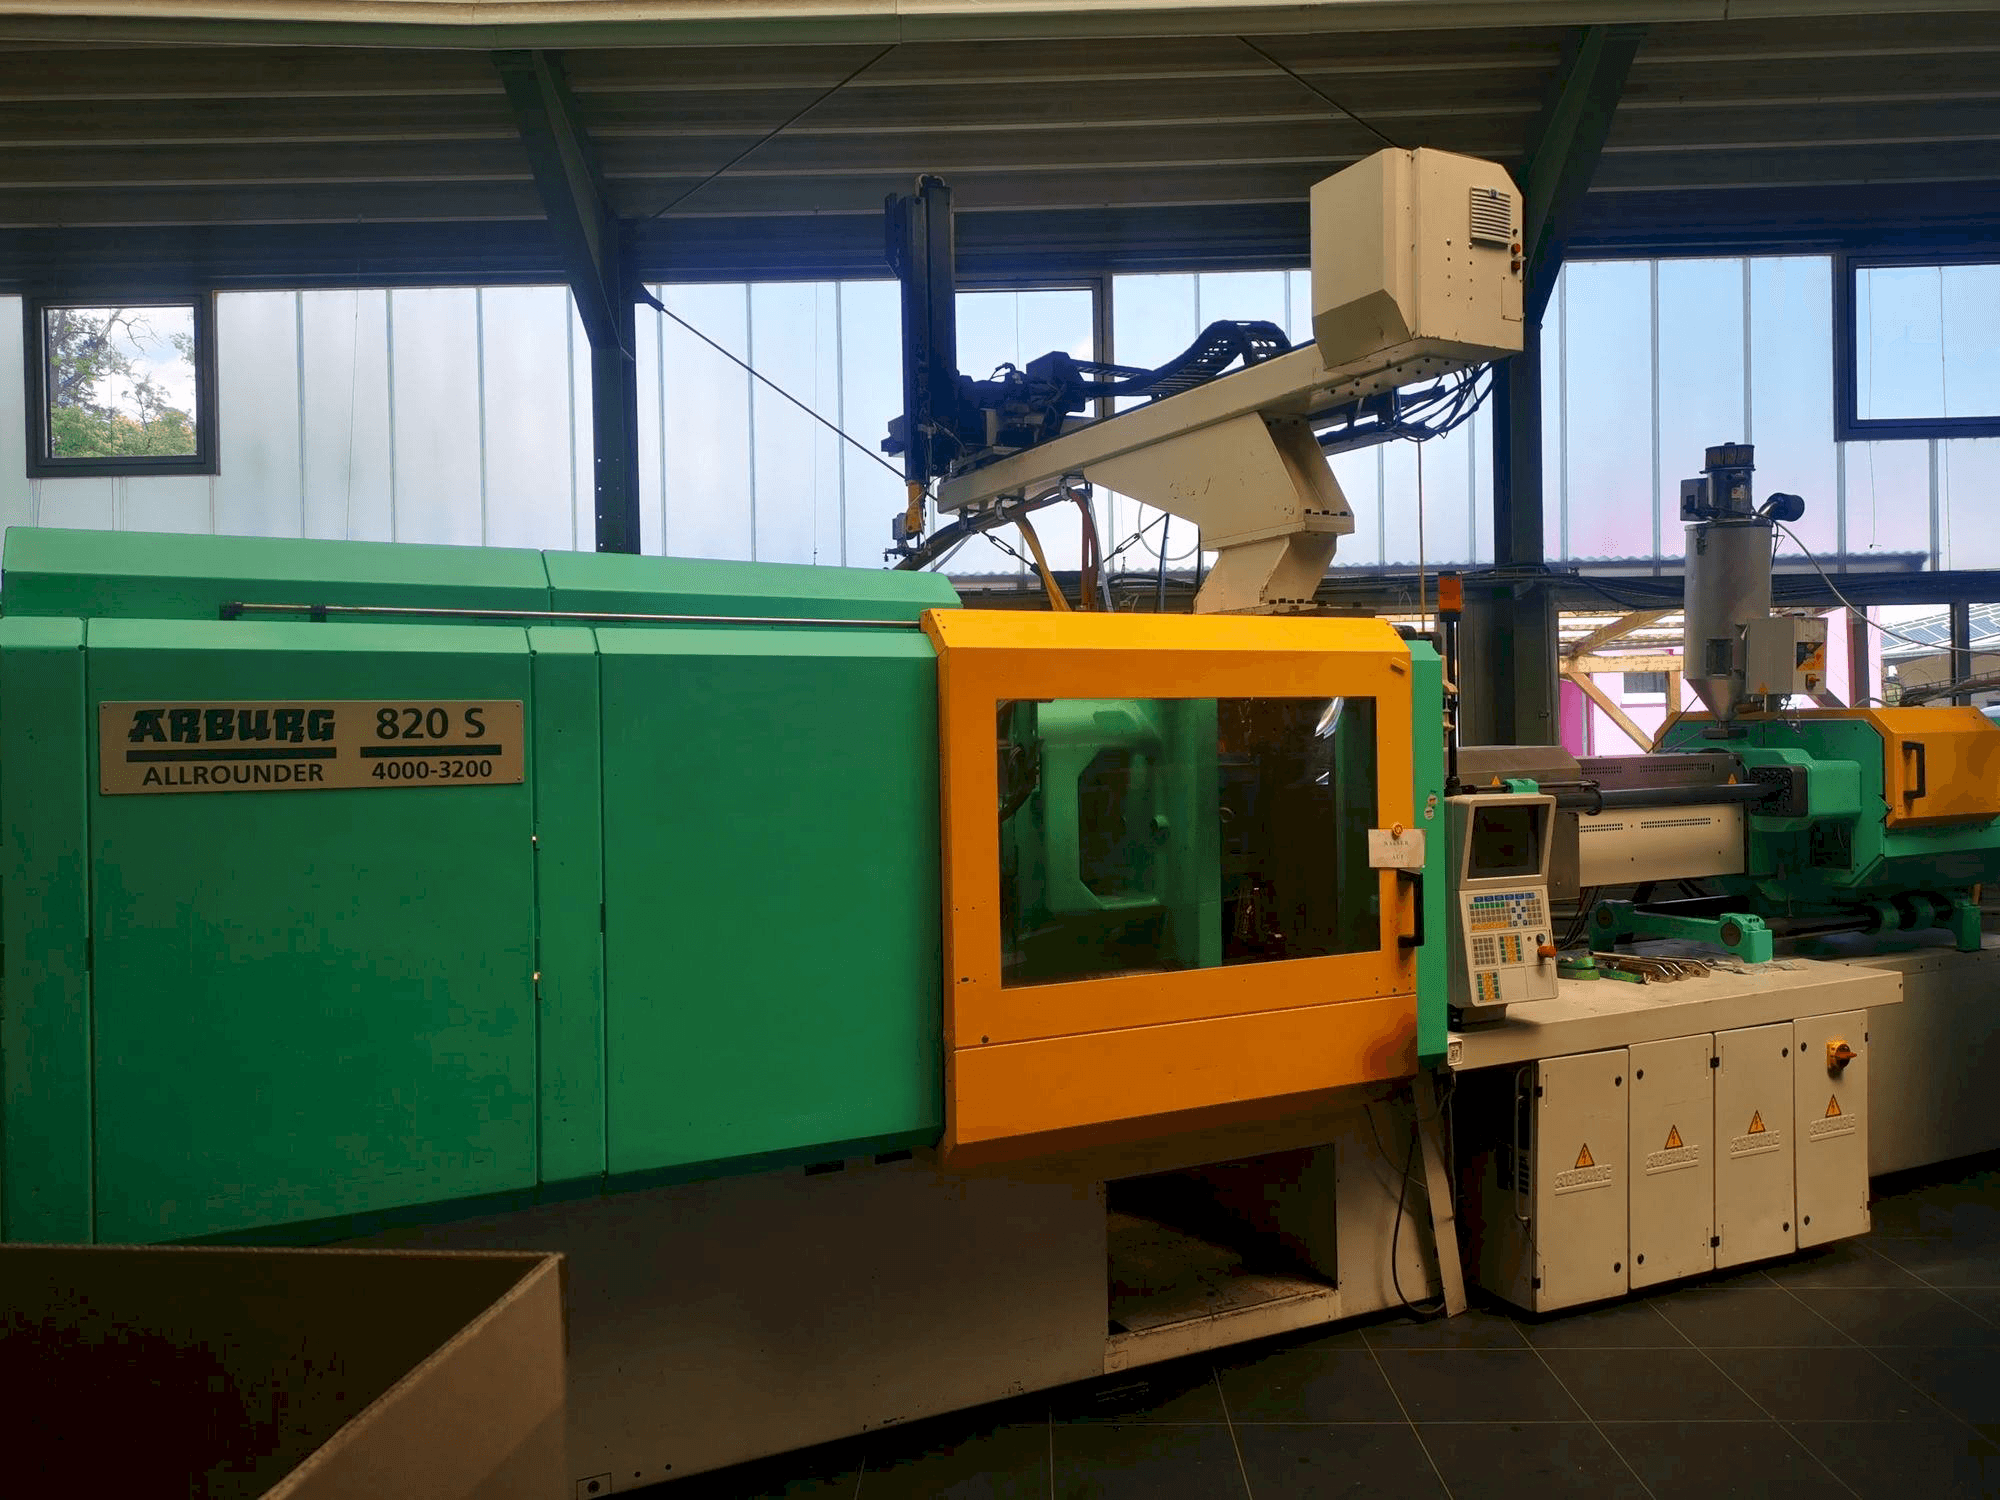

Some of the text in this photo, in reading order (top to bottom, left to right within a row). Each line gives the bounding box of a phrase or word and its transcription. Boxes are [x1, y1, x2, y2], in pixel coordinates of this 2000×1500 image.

[127, 708, 336, 743] ARBURG
[375, 706, 486, 740] 820 S
[142, 763, 324, 786] ALLROUNDER
[371, 759, 493, 781] 4000-3200
